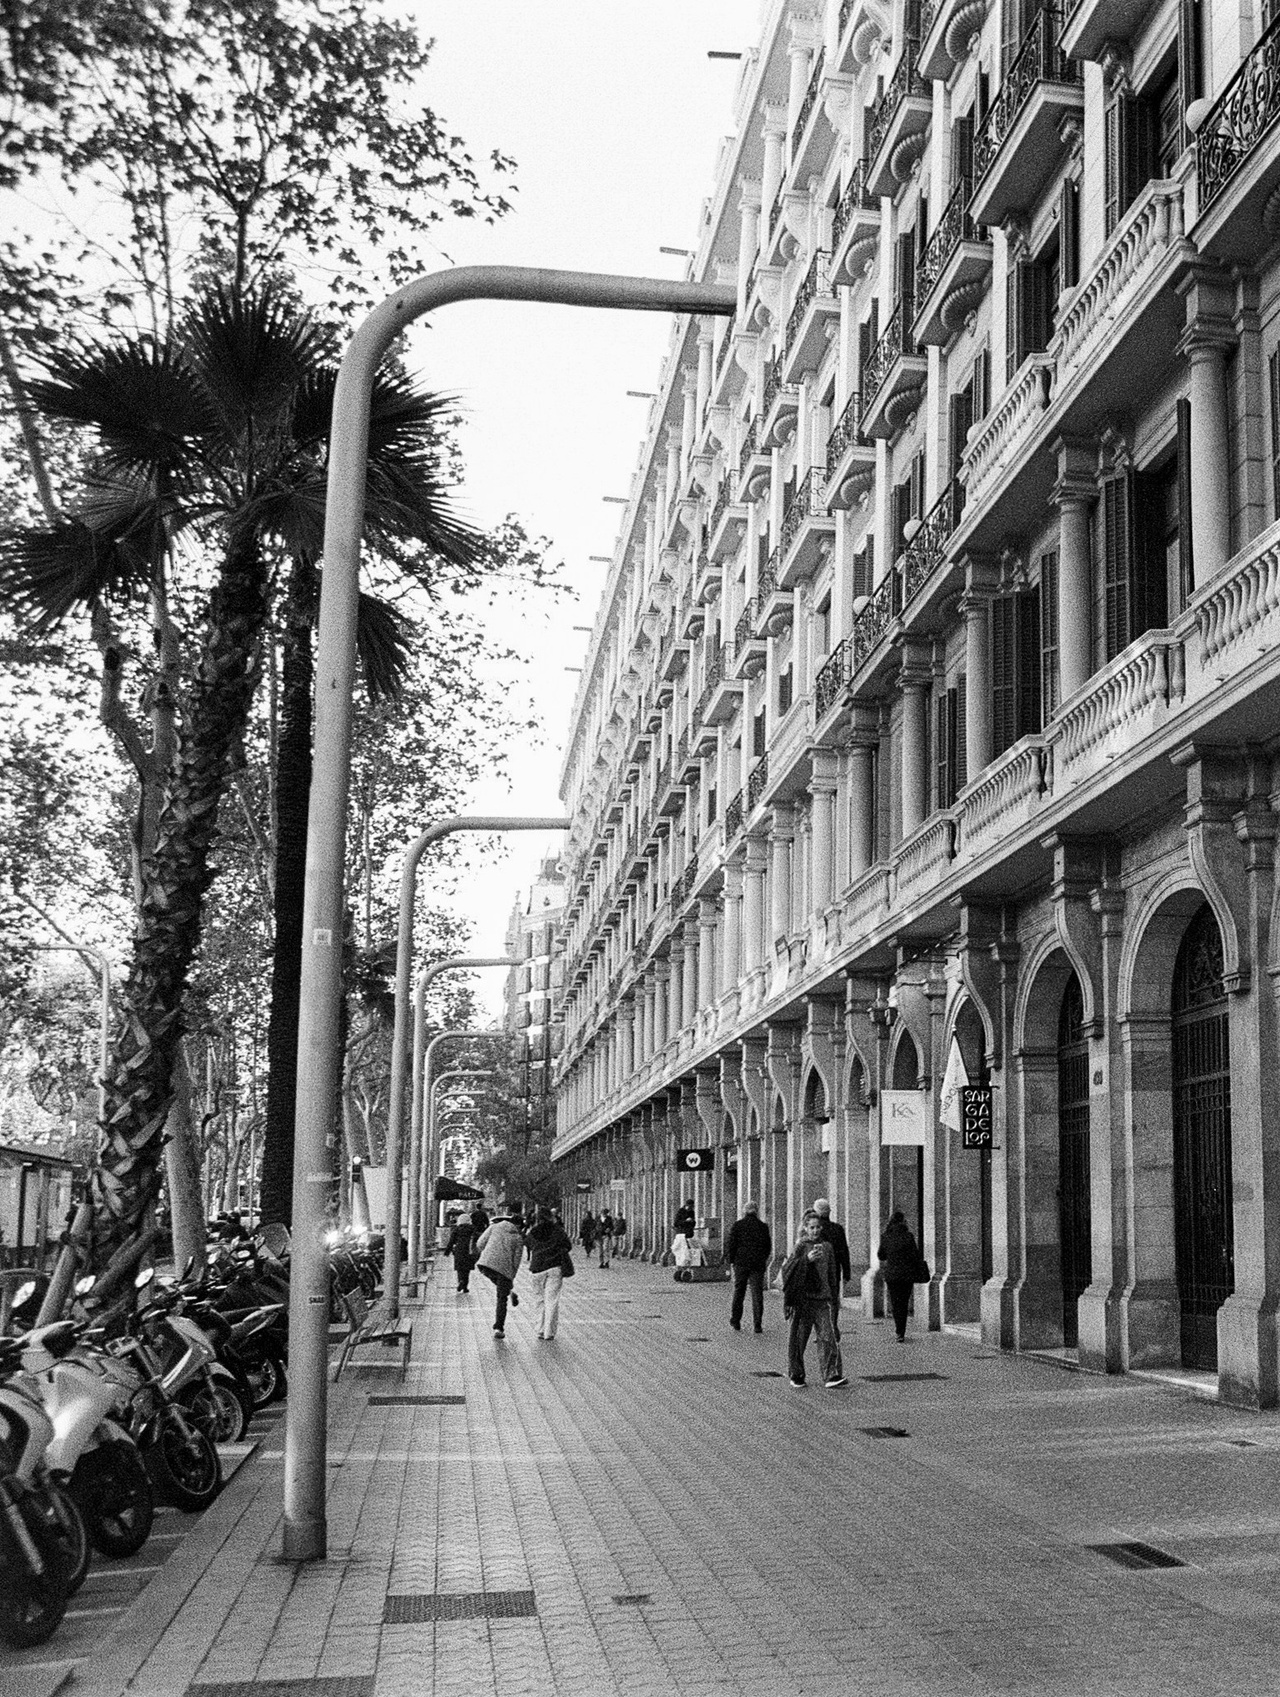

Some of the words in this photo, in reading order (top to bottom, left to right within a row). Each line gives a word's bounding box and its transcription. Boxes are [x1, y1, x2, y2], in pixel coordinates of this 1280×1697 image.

[965, 1090, 990, 1102] SAR
[965, 1103, 989, 1116] GA
[965, 1118, 990, 1131] DE
[965, 1131, 990, 1145] LOS
